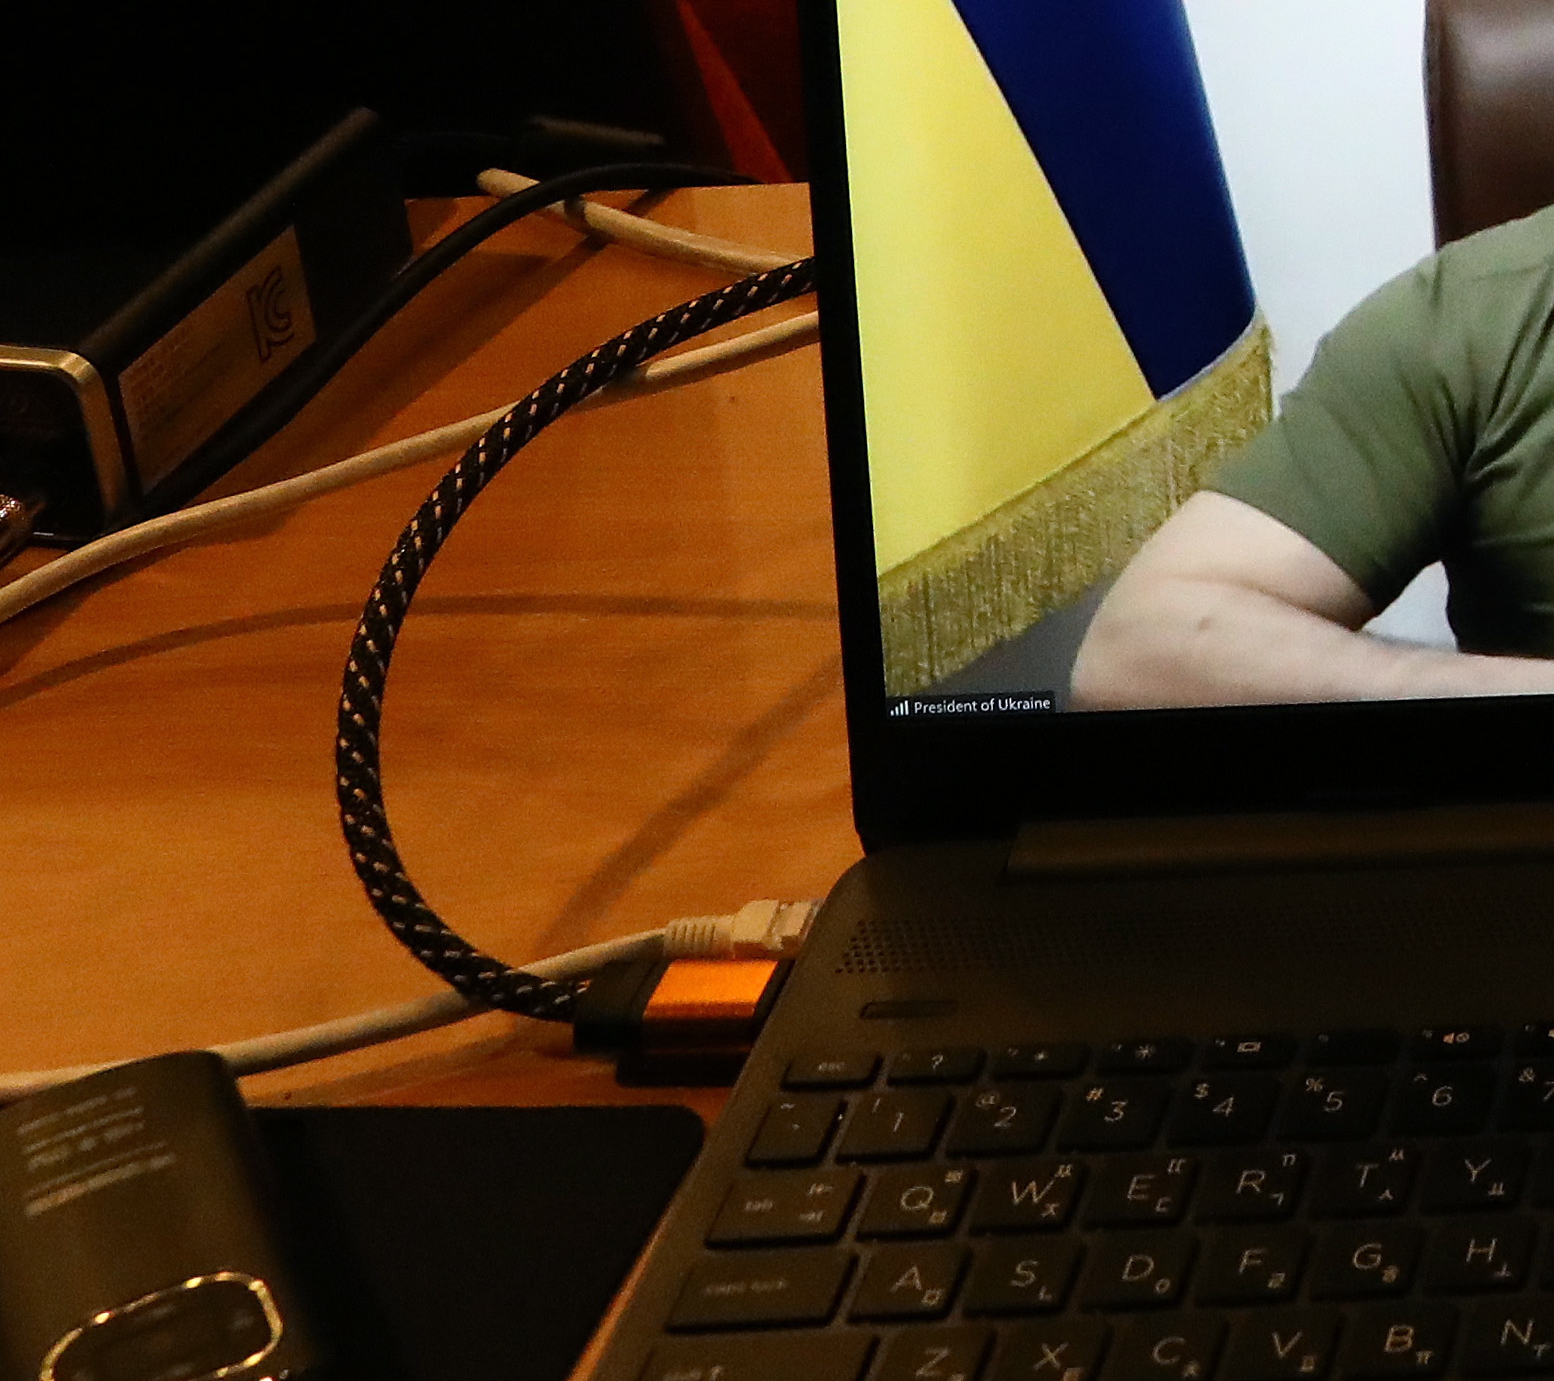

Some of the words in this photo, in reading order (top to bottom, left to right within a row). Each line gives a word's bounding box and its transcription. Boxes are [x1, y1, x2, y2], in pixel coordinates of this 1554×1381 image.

[914, 700, 978, 715] President
[980, 697, 995, 712] of
[998, 696, 1051, 711] Ukraine
